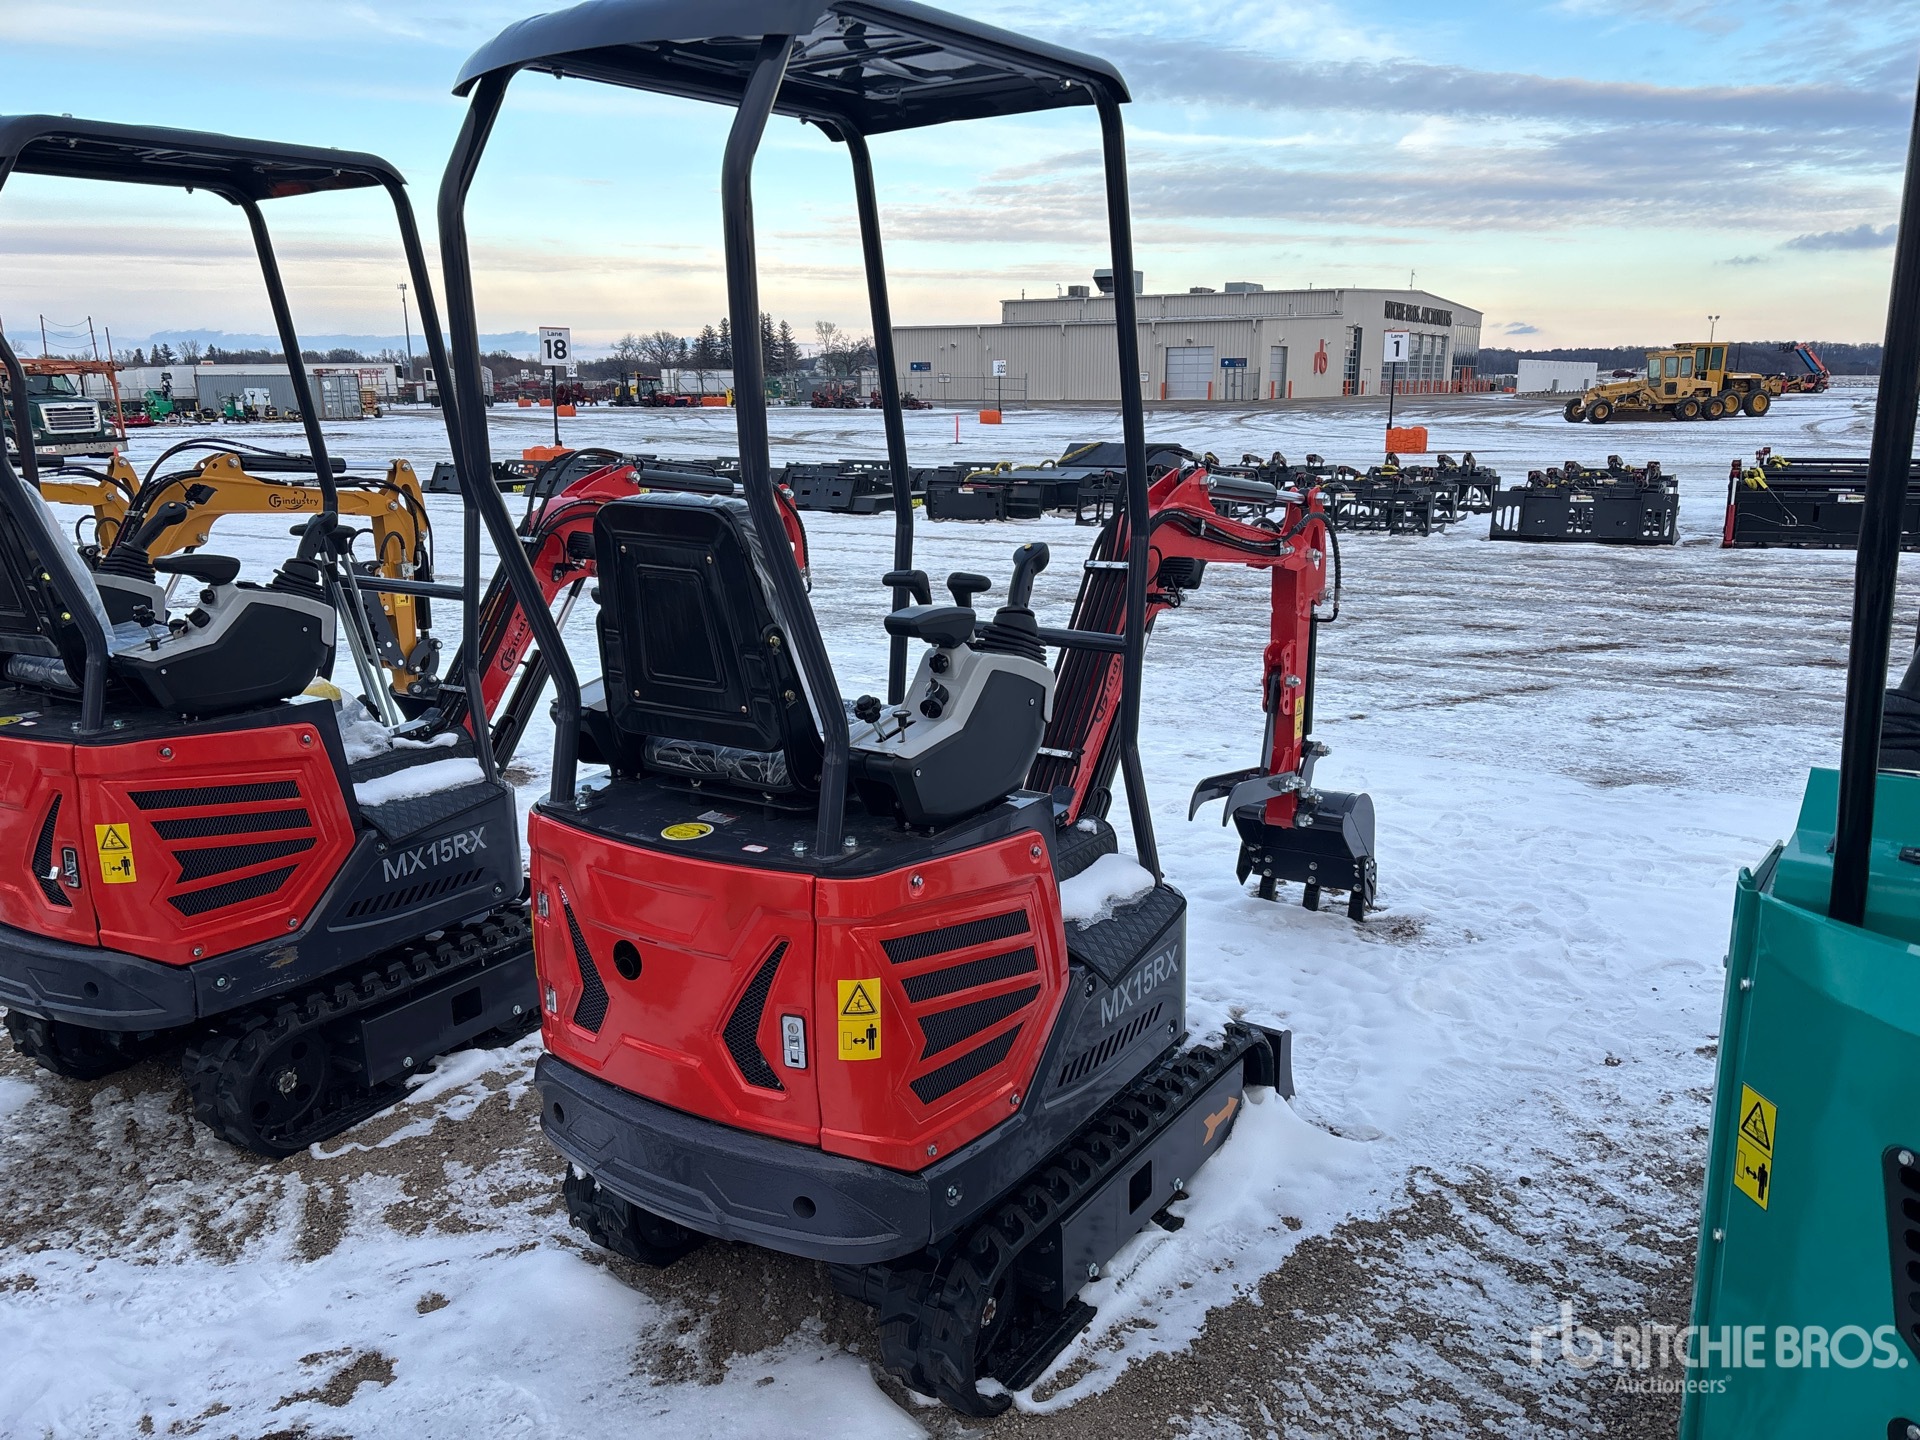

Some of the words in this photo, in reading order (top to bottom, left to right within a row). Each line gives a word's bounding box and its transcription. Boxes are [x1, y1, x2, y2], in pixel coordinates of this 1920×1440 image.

[543, 339, 568, 360] 18
[1393, 340, 1401, 358] 1
[382, 826, 488, 883] MX15RX
[1100, 944, 1178, 1029] MX15RX
